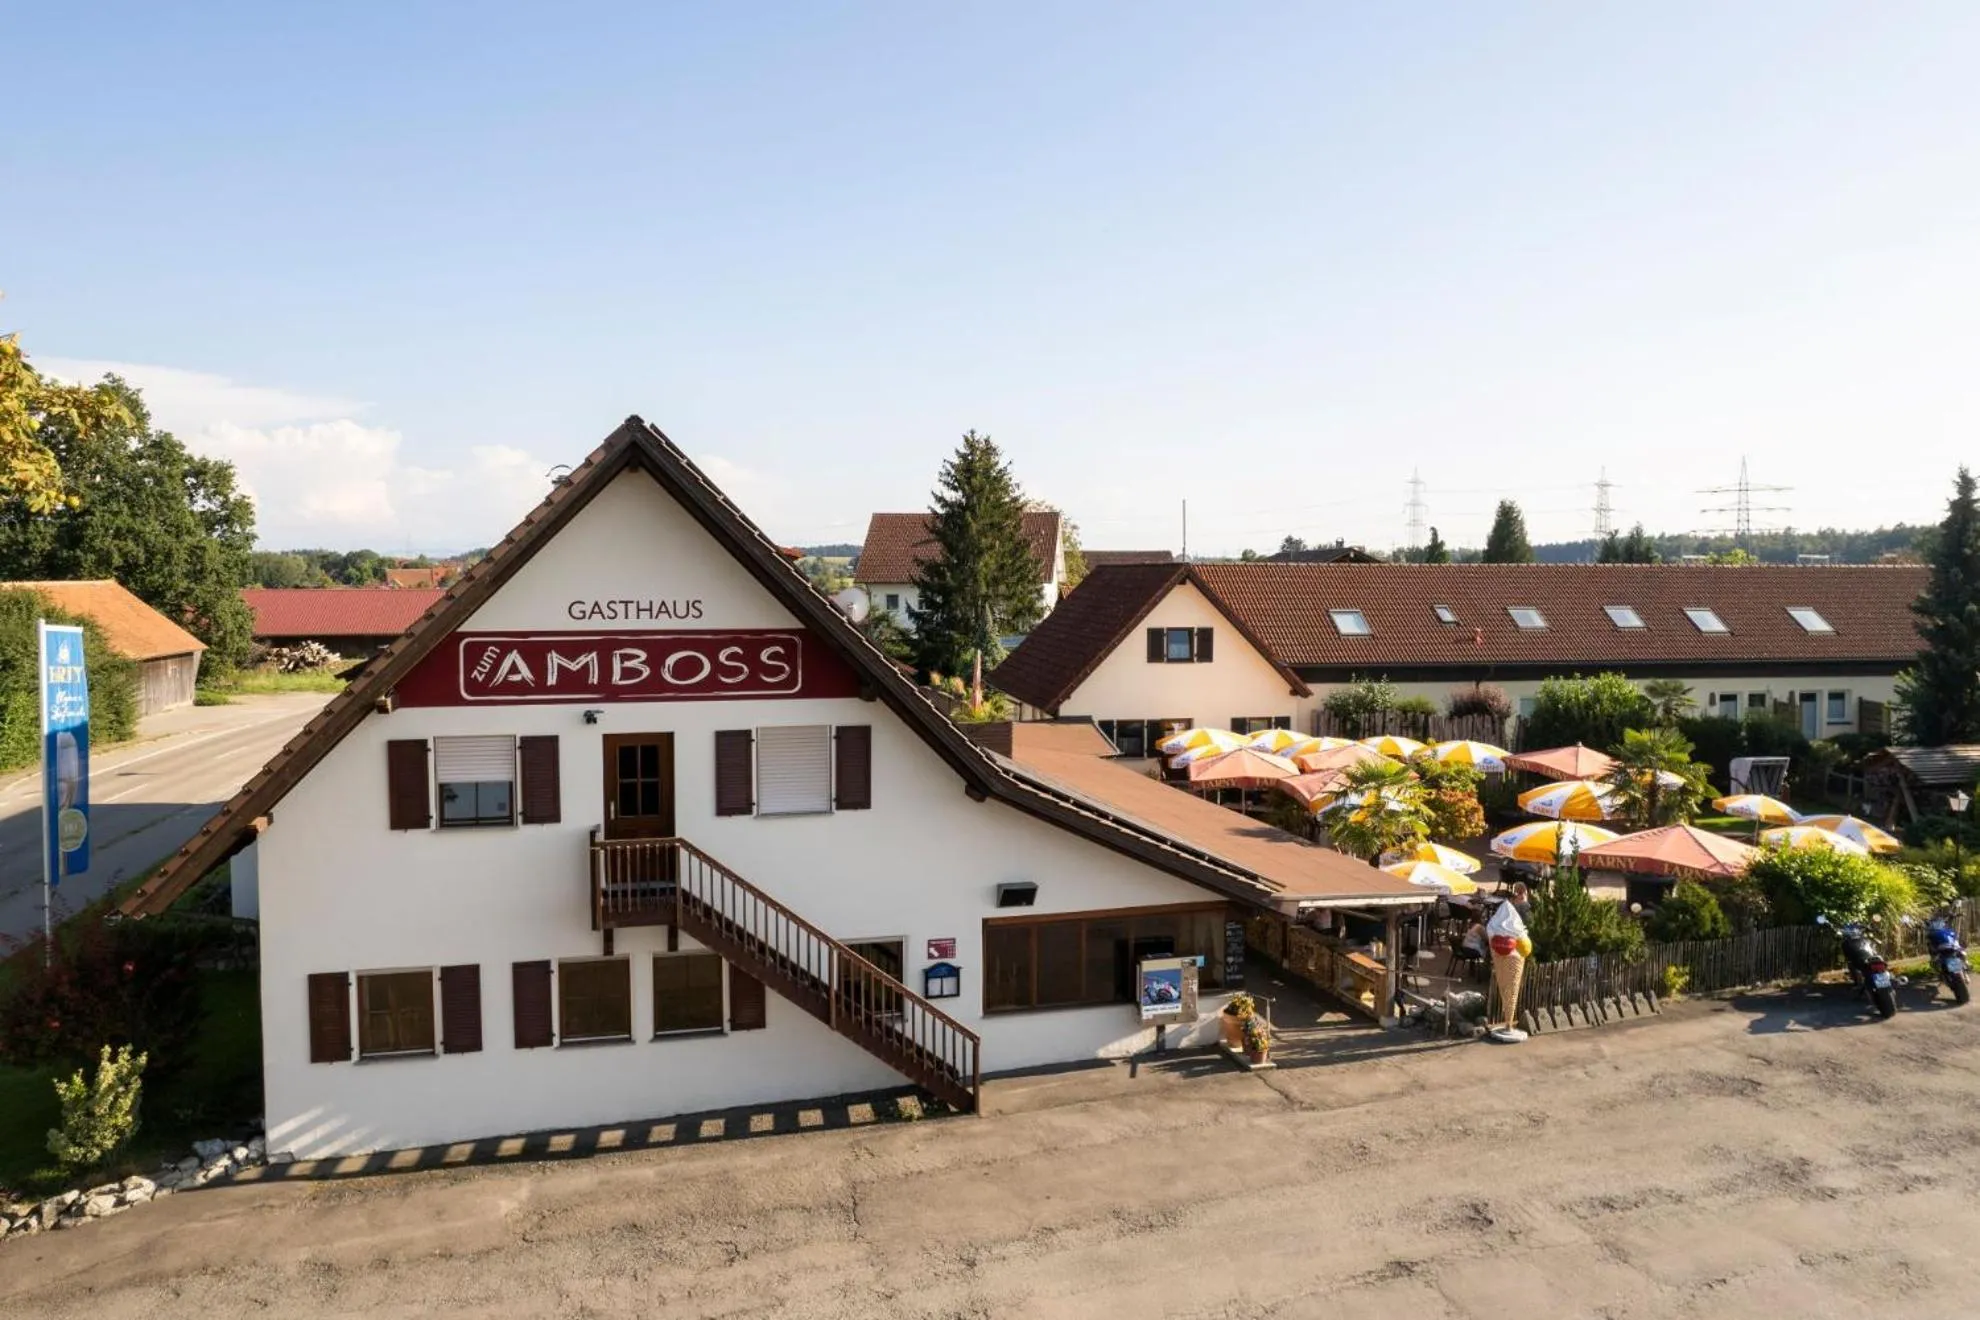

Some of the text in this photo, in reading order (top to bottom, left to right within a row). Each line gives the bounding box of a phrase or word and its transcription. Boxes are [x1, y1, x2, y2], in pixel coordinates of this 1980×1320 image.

[568, 599, 704, 620] GASTHAUS
[489, 646, 791, 688] AMBOSS
[1588, 855, 1637, 869] FARNY
